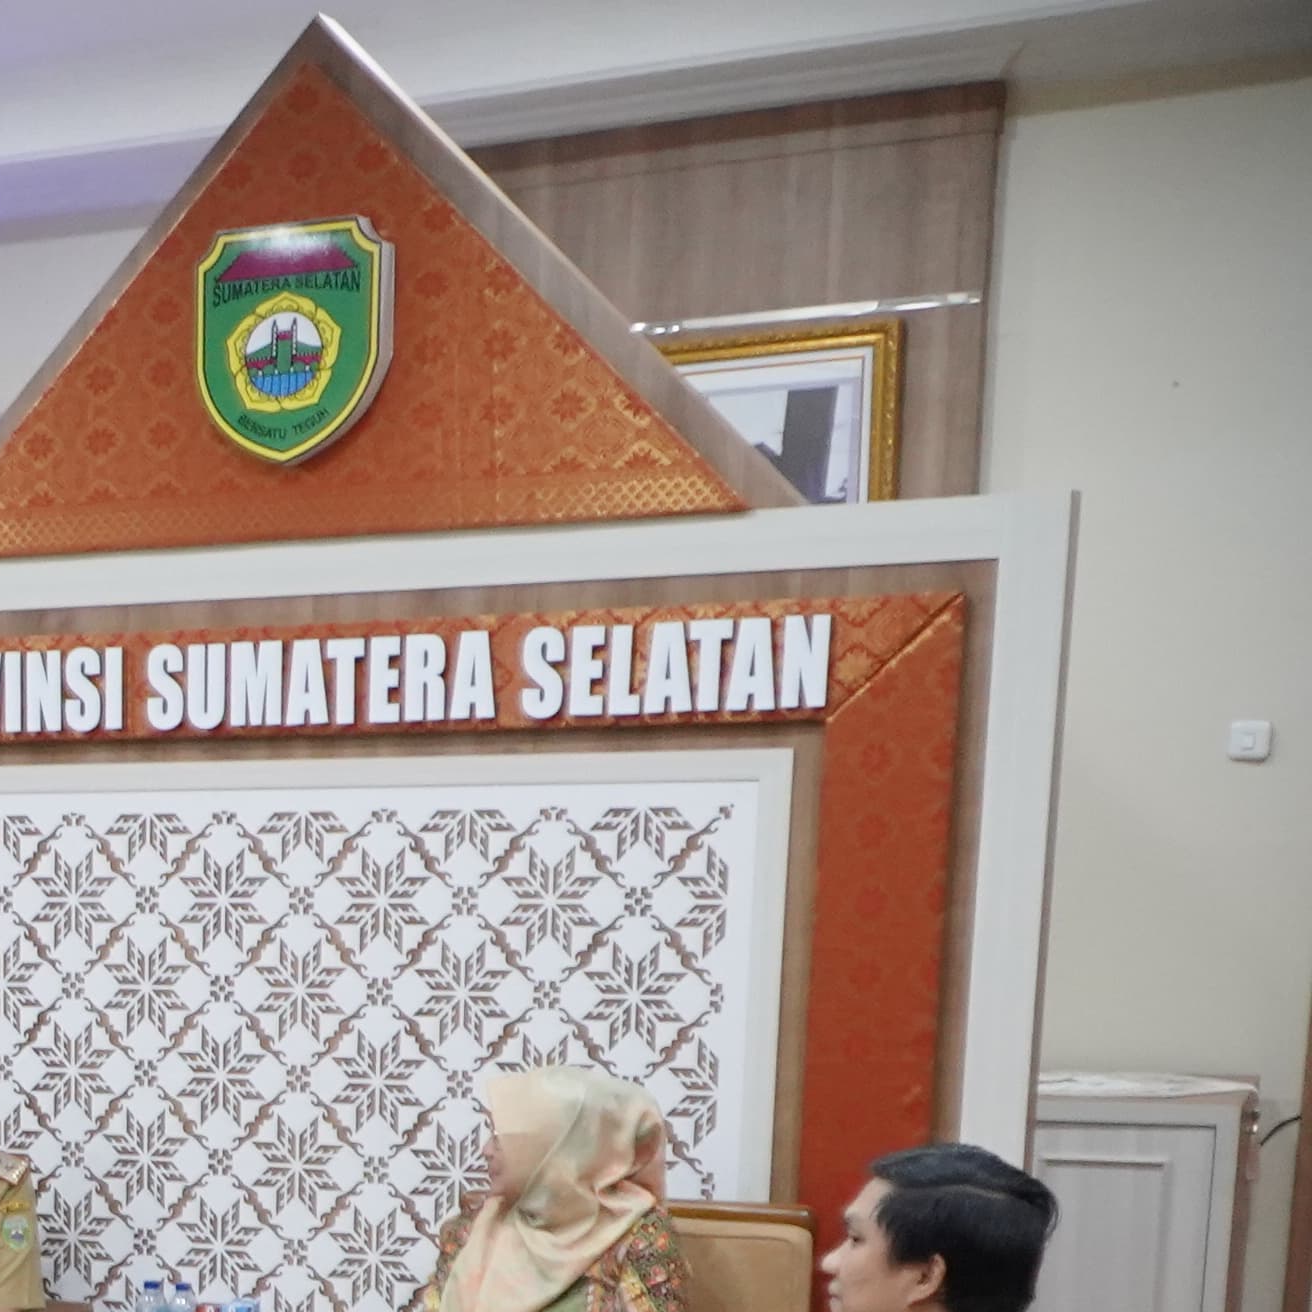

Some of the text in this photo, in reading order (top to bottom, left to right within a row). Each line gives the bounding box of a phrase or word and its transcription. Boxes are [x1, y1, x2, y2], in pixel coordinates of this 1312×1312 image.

[212, 271, 361, 307] SUMATERA SELATAN
[147, 631, 496, 731] SUMATERA
[521, 614, 832, 720] SELATAN
